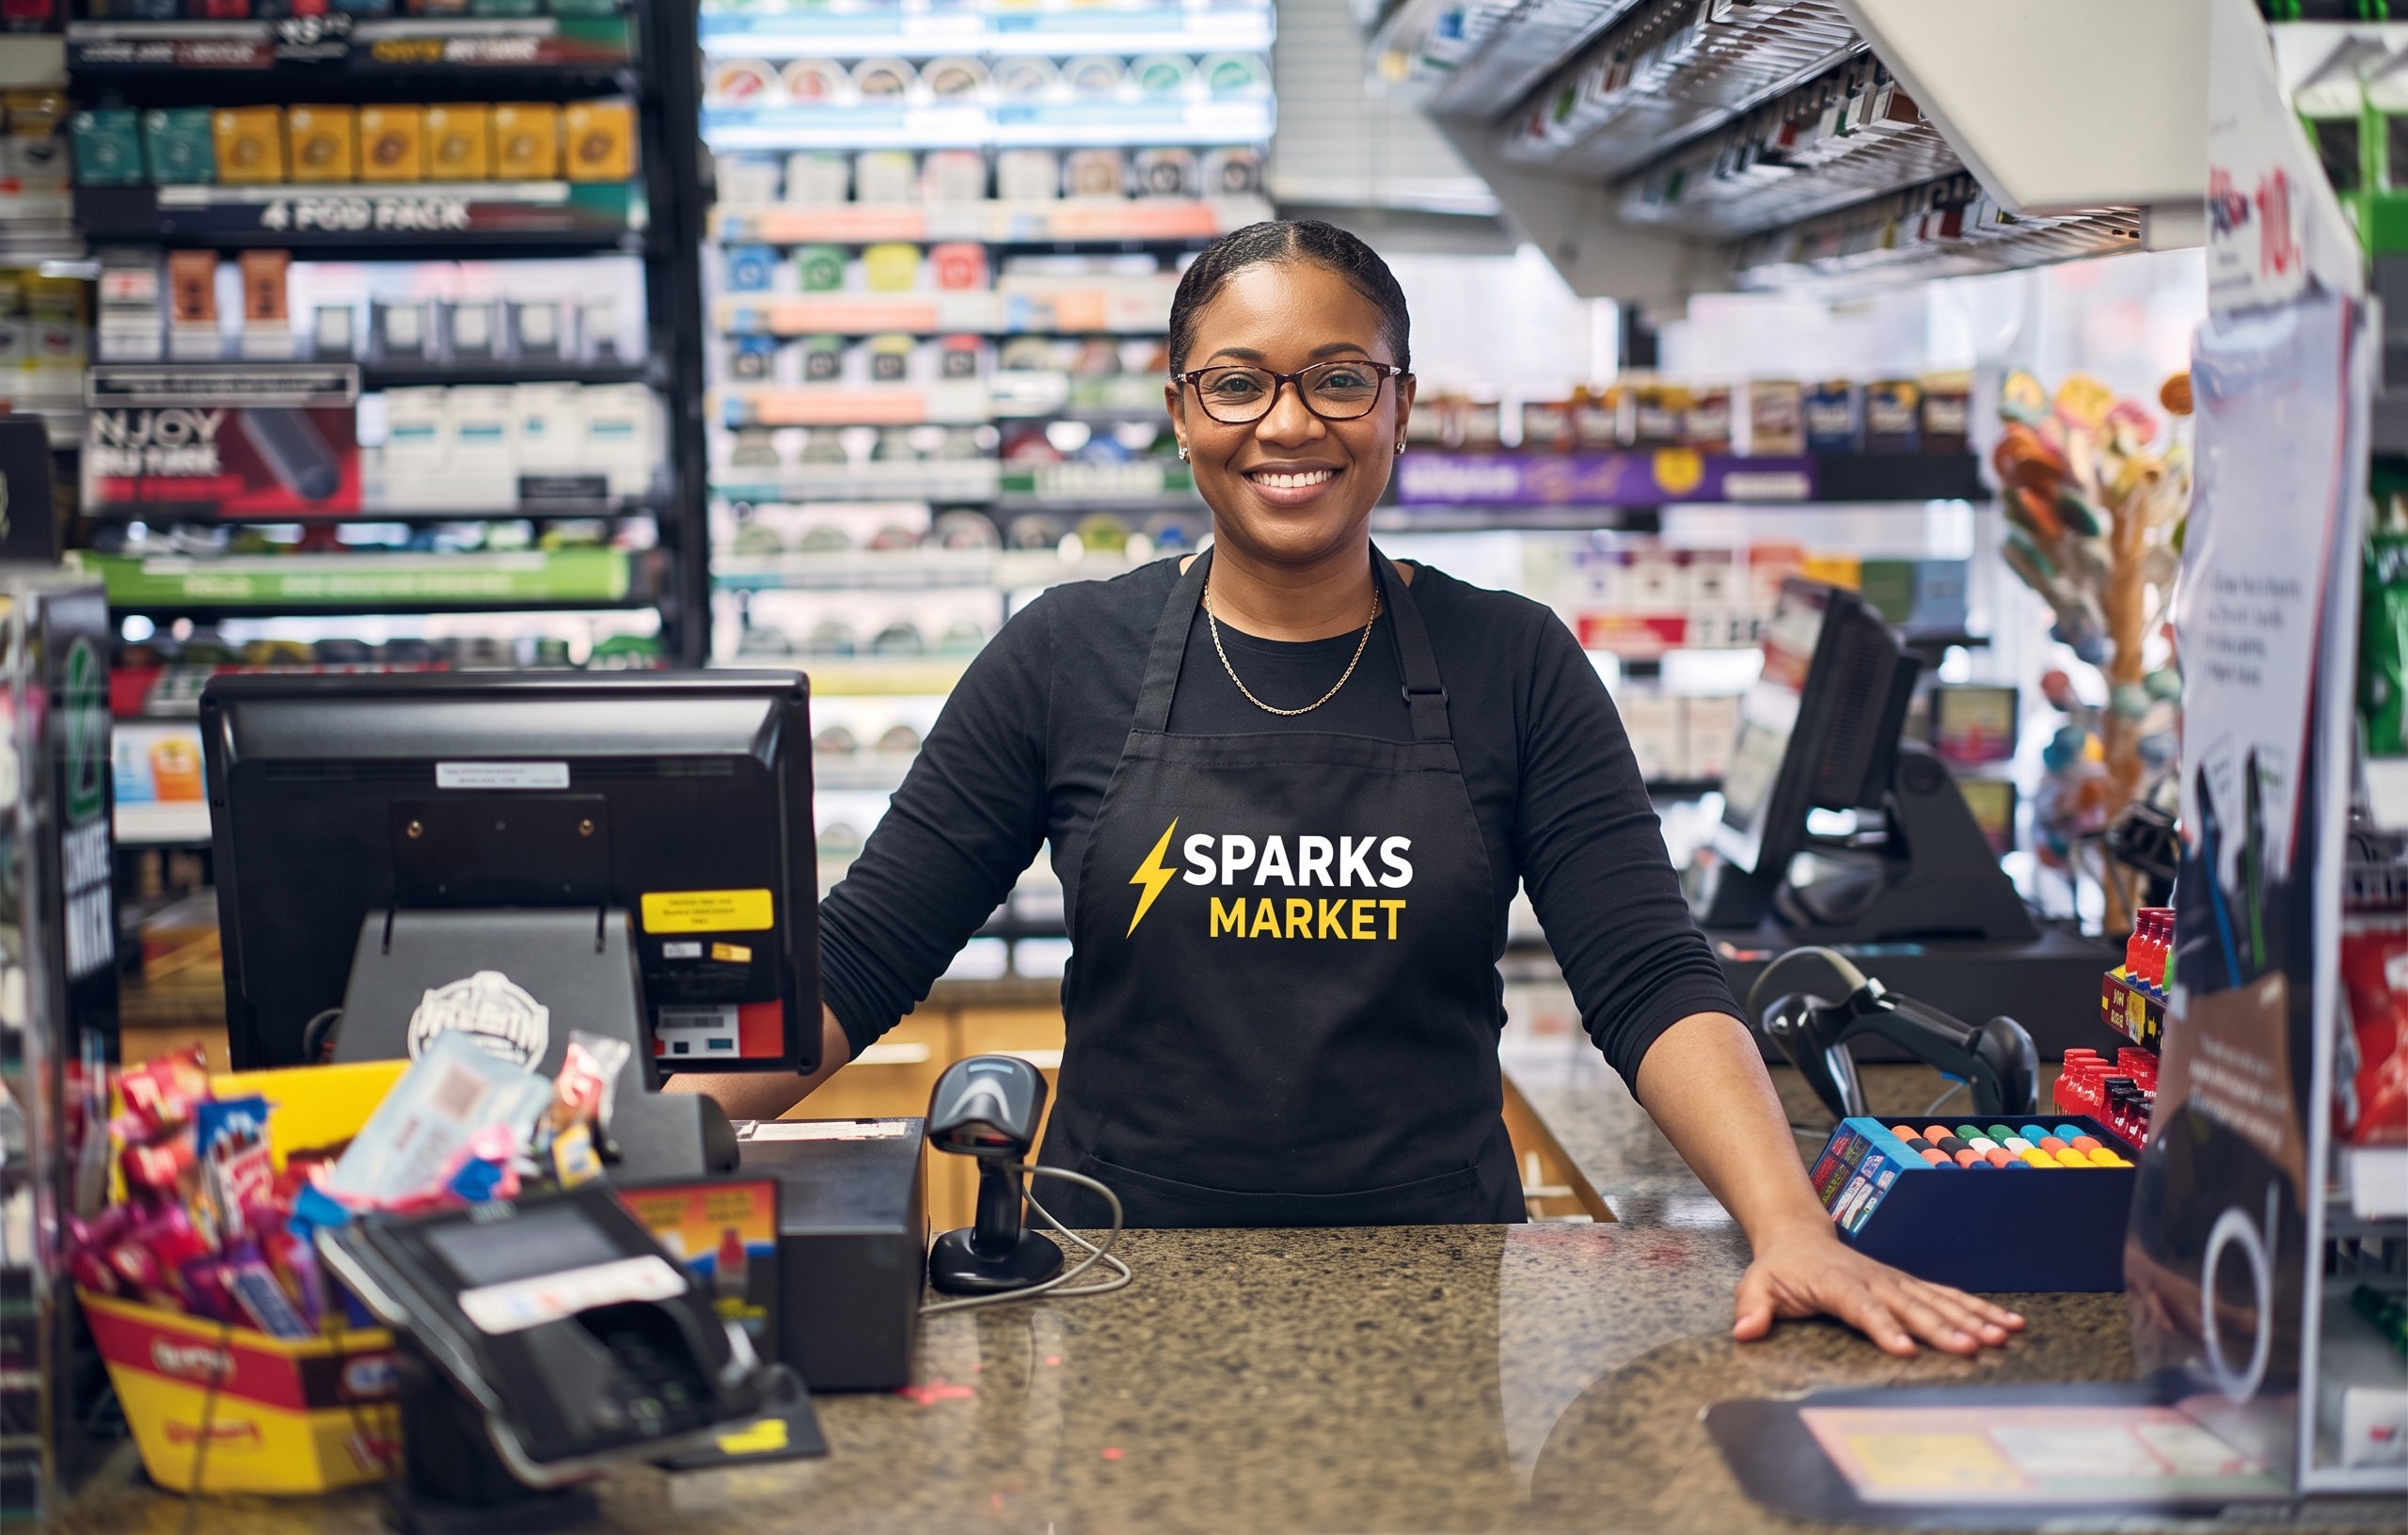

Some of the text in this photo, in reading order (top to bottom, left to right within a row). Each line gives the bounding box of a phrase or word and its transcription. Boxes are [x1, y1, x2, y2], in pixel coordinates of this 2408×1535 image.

[92, 407, 226, 449] NJOY
[1182, 833, 1414, 889] SPARKS
[1210, 896, 1406, 941] MARKET
